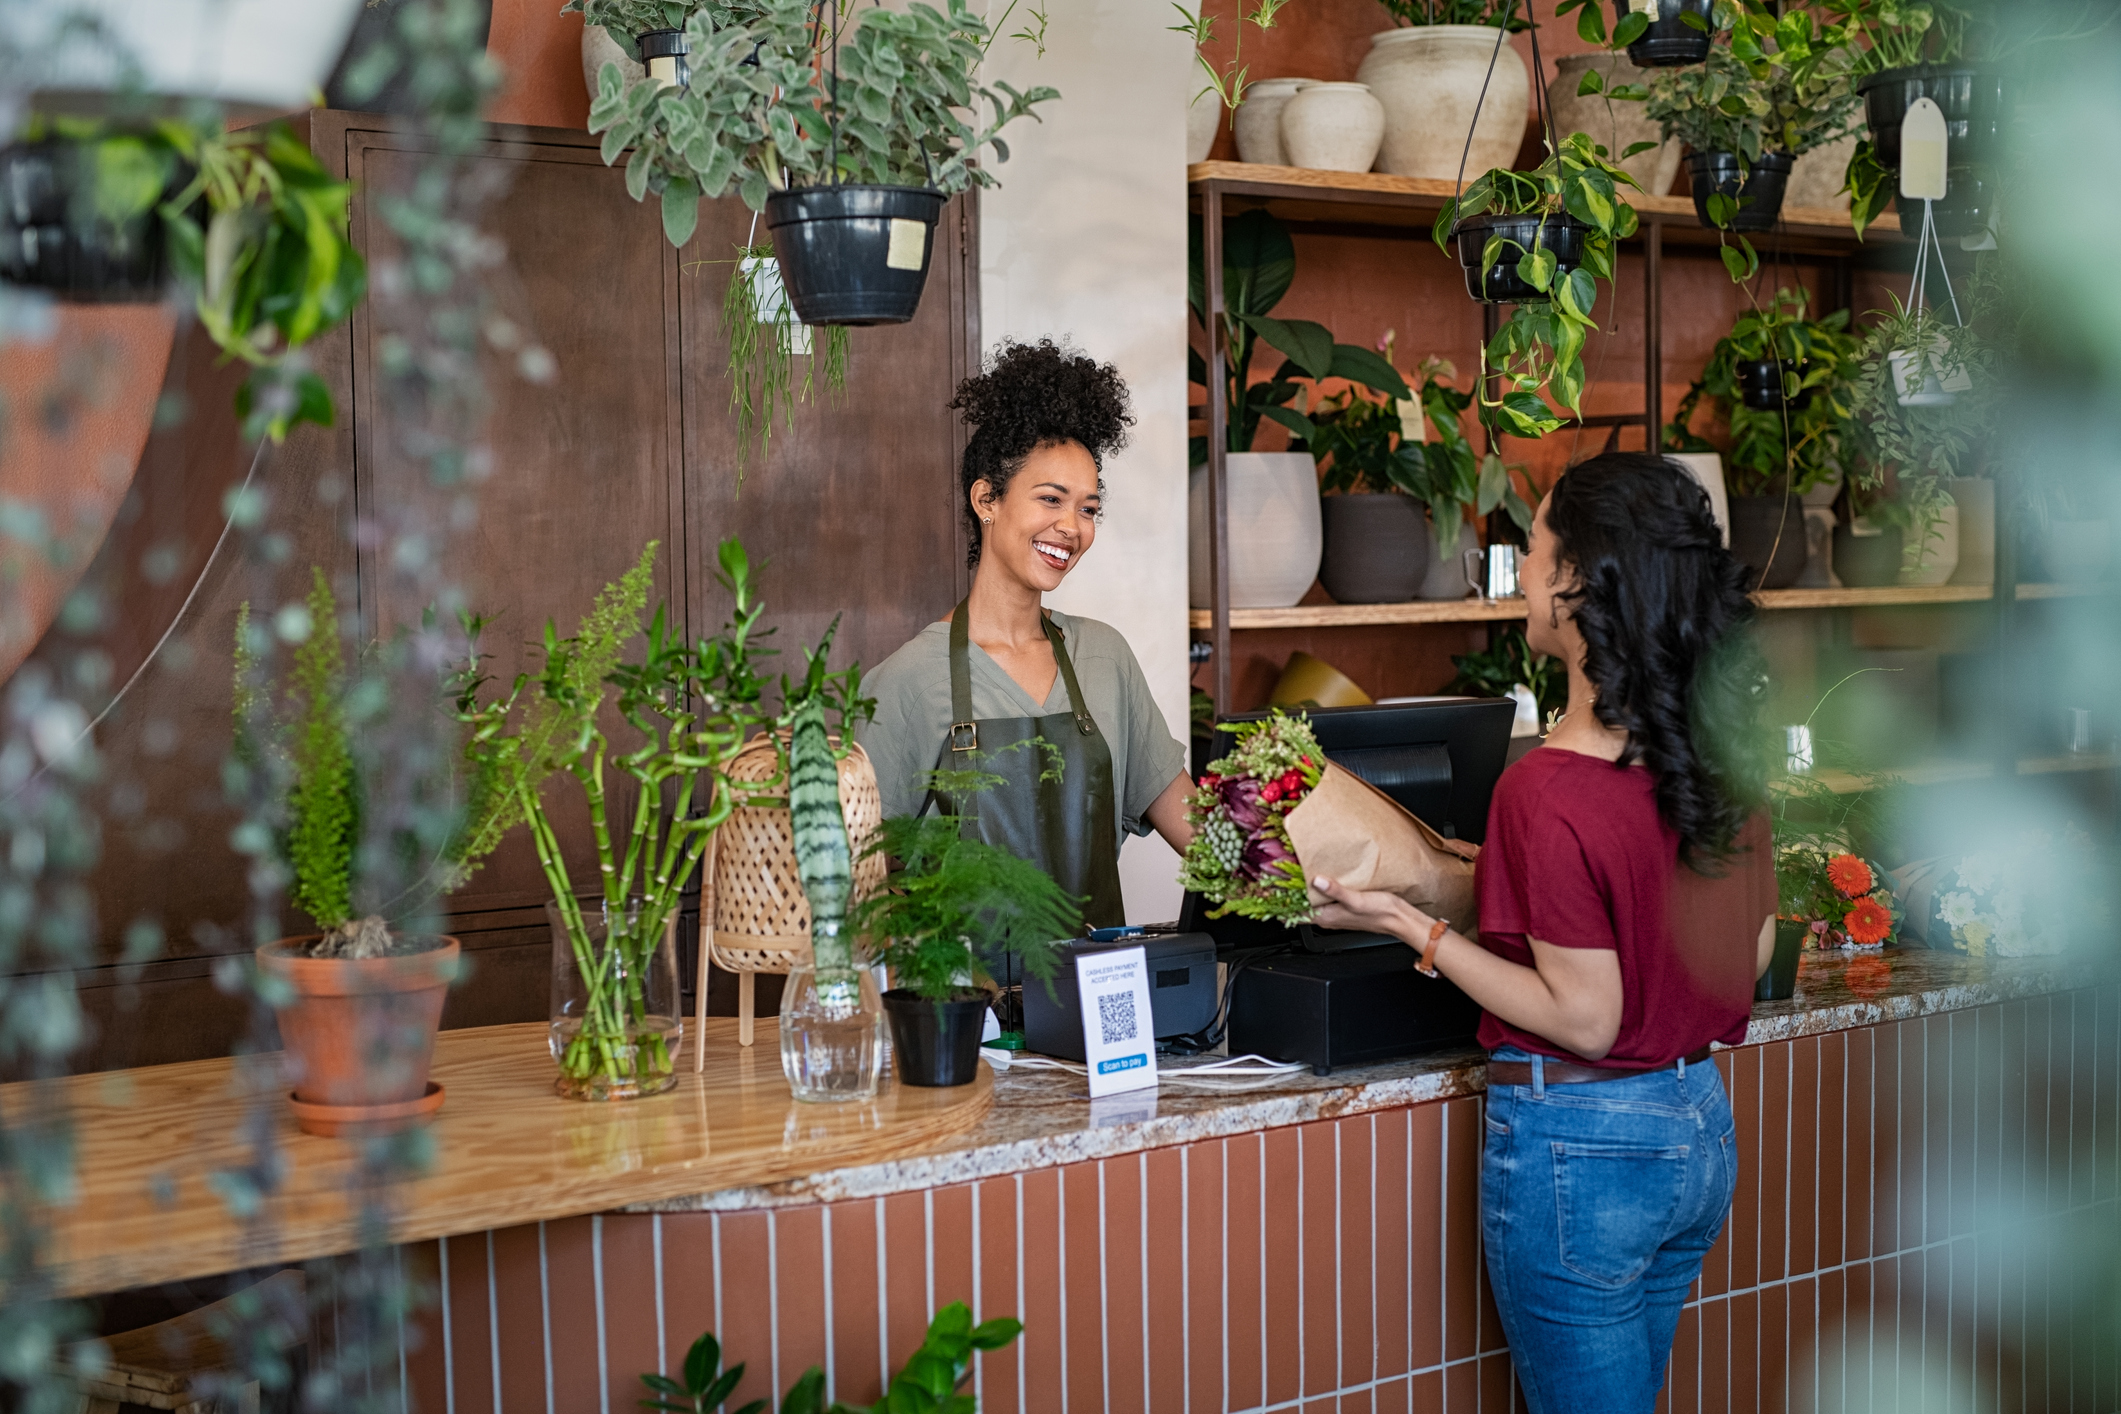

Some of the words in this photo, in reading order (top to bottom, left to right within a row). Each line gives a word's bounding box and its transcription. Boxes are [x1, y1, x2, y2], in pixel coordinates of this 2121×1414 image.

[1085, 966, 1113, 977] CASHLESS
[1114, 962, 1138, 971] PAYMENT
[1091, 974, 1119, 984] ACCEPTED
[1120, 971, 1134, 979] HERE
[1103, 1062, 1120, 1072] Scan
[1121, 1060, 1128, 1068] to
[1129, 1058, 1142, 1068] pay
